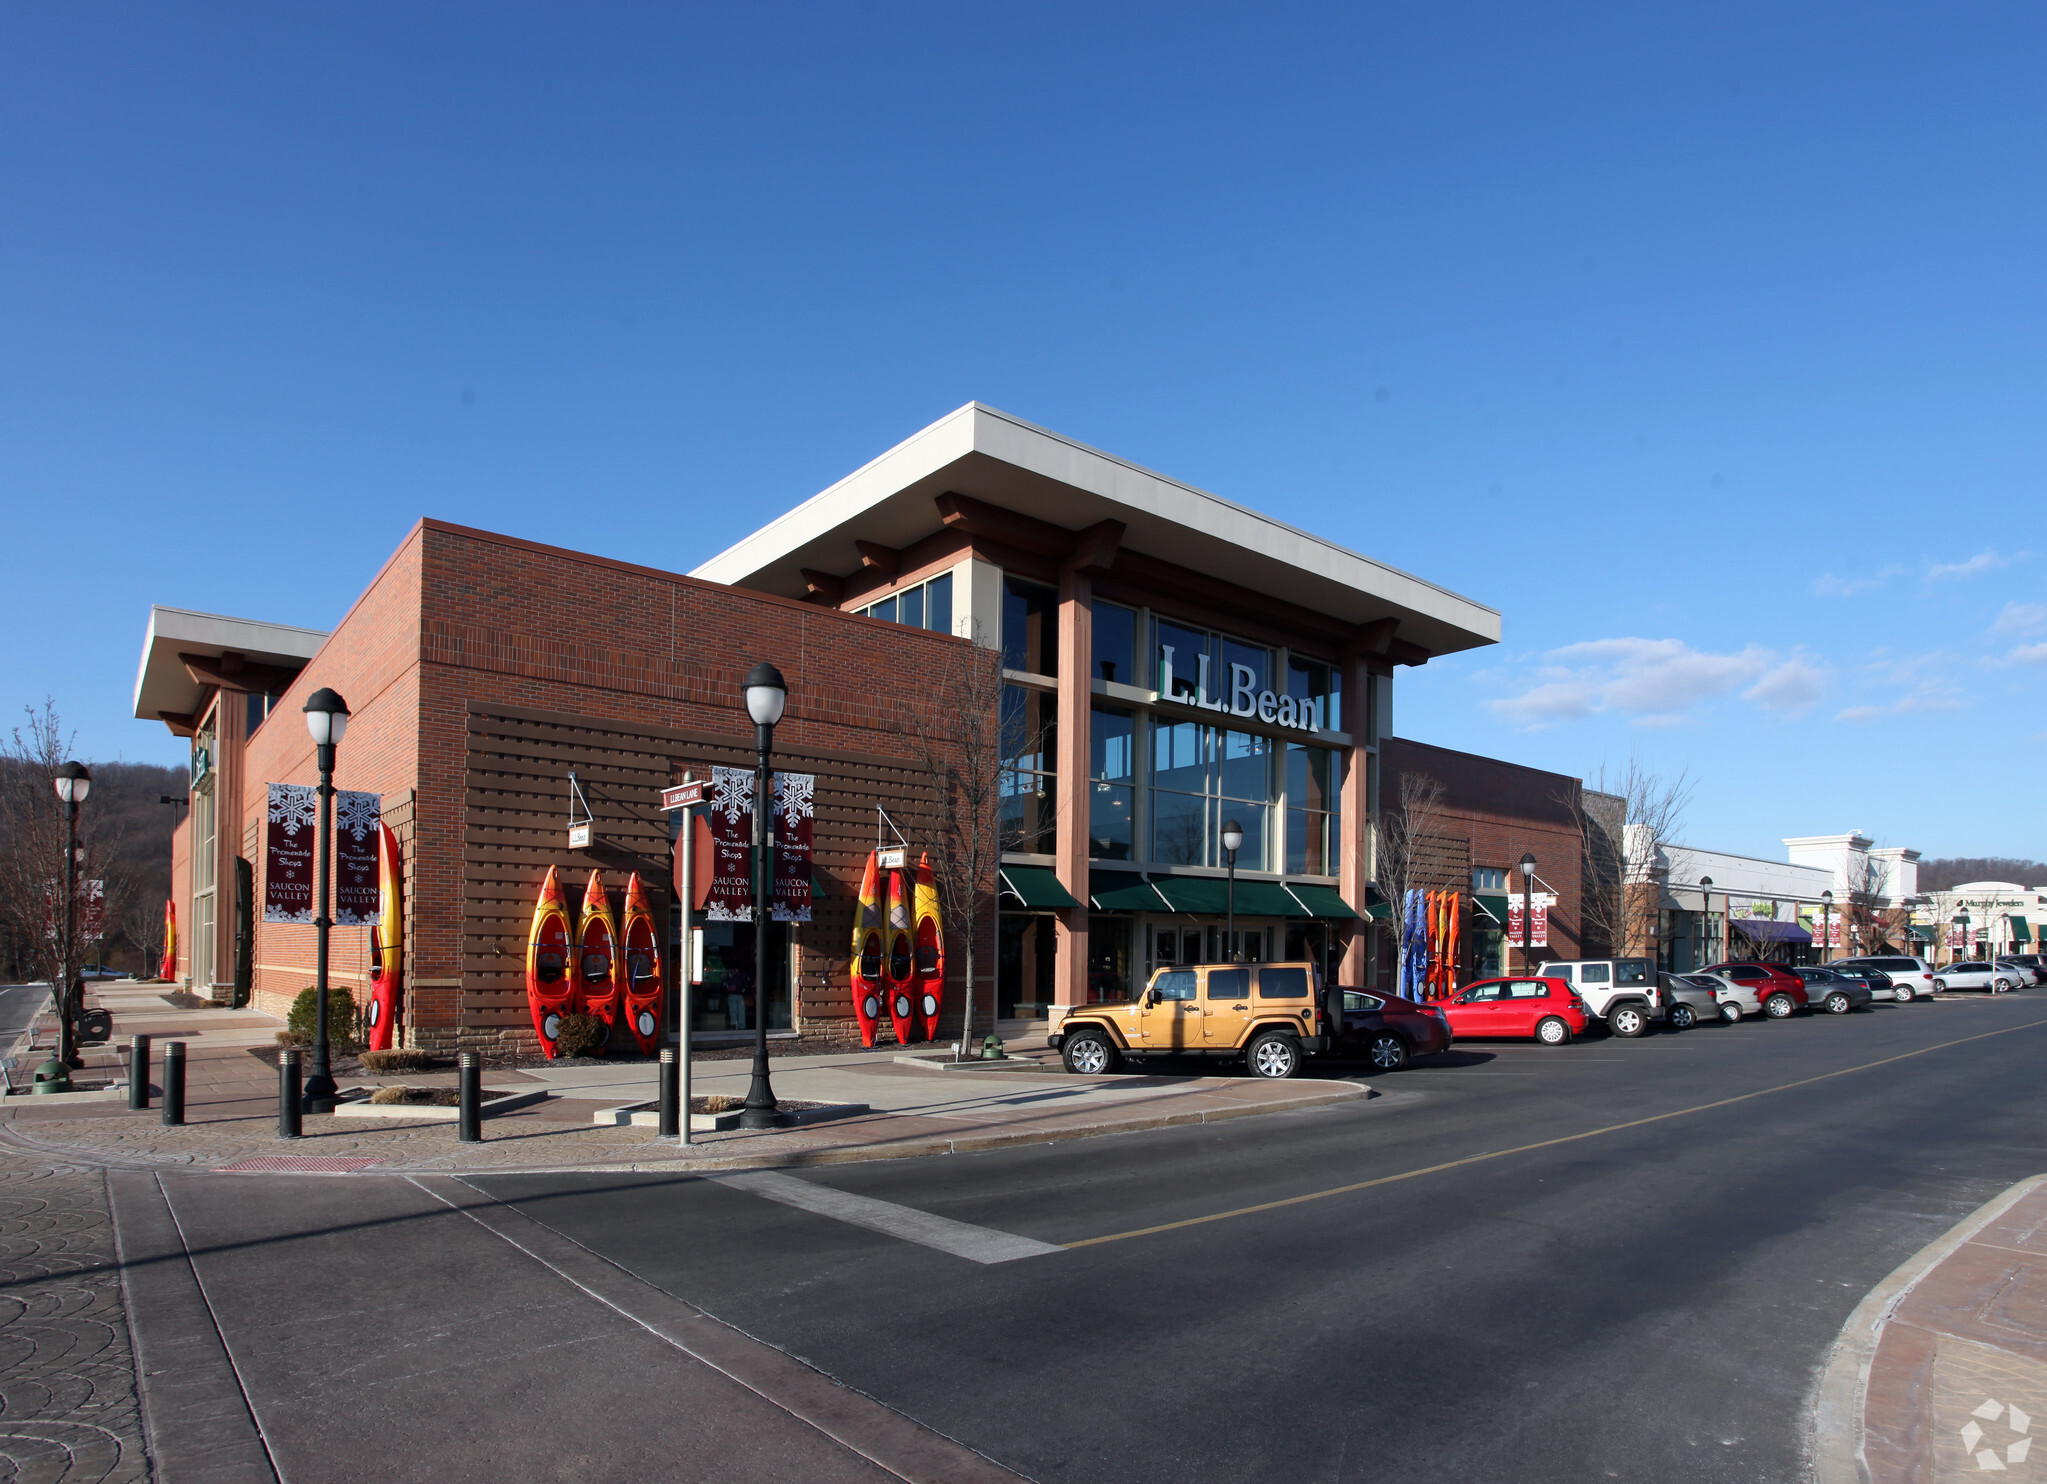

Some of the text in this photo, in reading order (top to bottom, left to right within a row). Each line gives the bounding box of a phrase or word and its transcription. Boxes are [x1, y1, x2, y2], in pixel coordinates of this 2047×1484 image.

[1160, 644, 1319, 733] L.L.Bean
[687, 788, 698, 799] LANE
[725, 829, 739, 839] The
[786, 832, 799, 841] The
[283, 839, 298, 848] The
[714, 837, 750, 848] Promenade
[775, 840, 810, 851] Promenade
[269, 846, 311, 857] Promenade
[351, 845, 365, 853] The
[339, 852, 378, 862] Promenade
[721, 849, 742, 860] Shops
[782, 852, 803, 862] Shops
[278, 857, 302, 867] Shops
[347, 862, 370, 872] Shops
[269, 882, 310, 891] SAUCON
[713, 877, 750, 886] SAUCON
[775, 879, 809, 887] SAUCON
[269, 891, 310, 900] VALLEY
[340, 887, 377, 895] SAUCON
[713, 886, 749, 896] VALLEY
[775, 888, 808, 897] VALLEY
[340, 896, 377, 904] VALLEY
[1965, 899, 2024, 909] Murphy Jewelers
